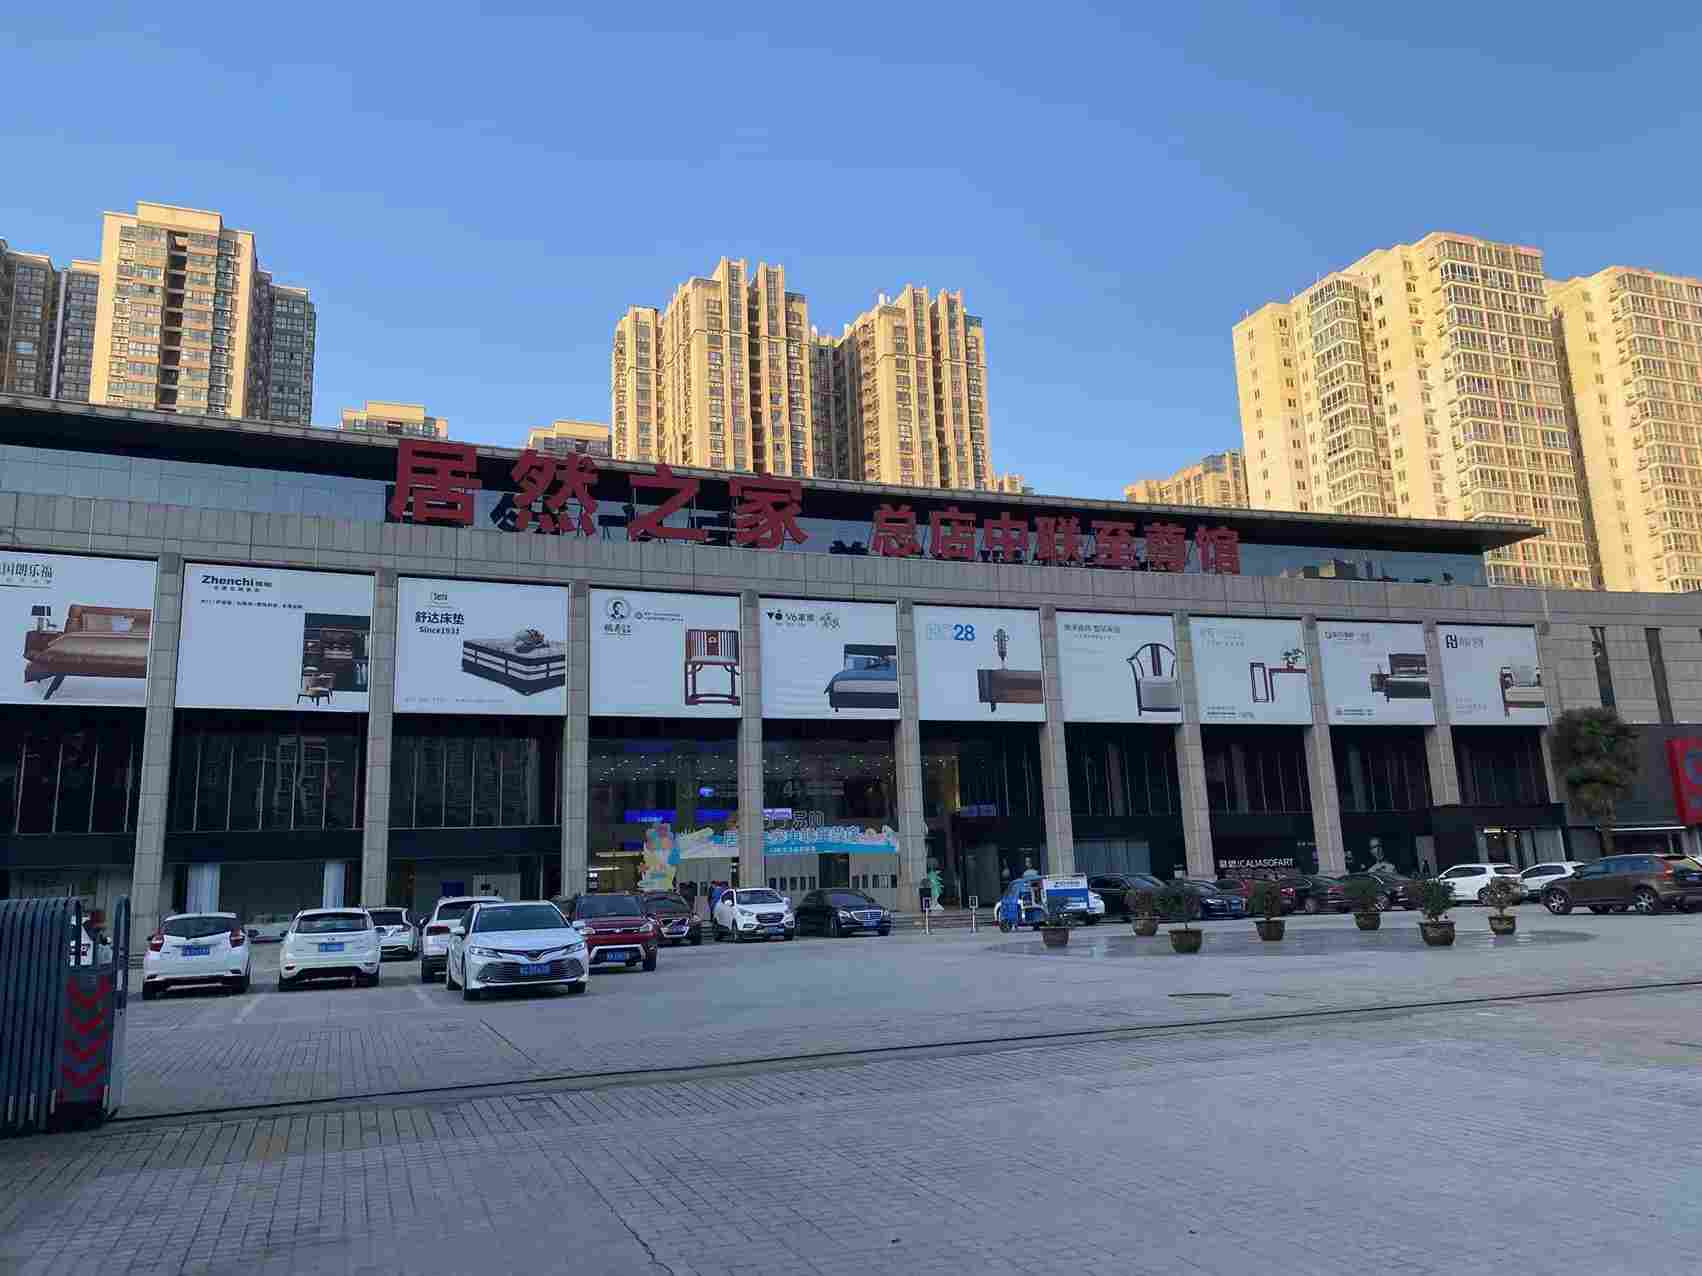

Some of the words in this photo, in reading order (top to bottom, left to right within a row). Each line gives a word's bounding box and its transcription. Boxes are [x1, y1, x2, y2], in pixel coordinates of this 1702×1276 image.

[388, 438, 808, 549] 居然之家
[869, 503, 1240, 576] 总店中联至尊馆
[415, 609, 465, 626] 舒达床垫
[952, 623, 977, 641] 28
